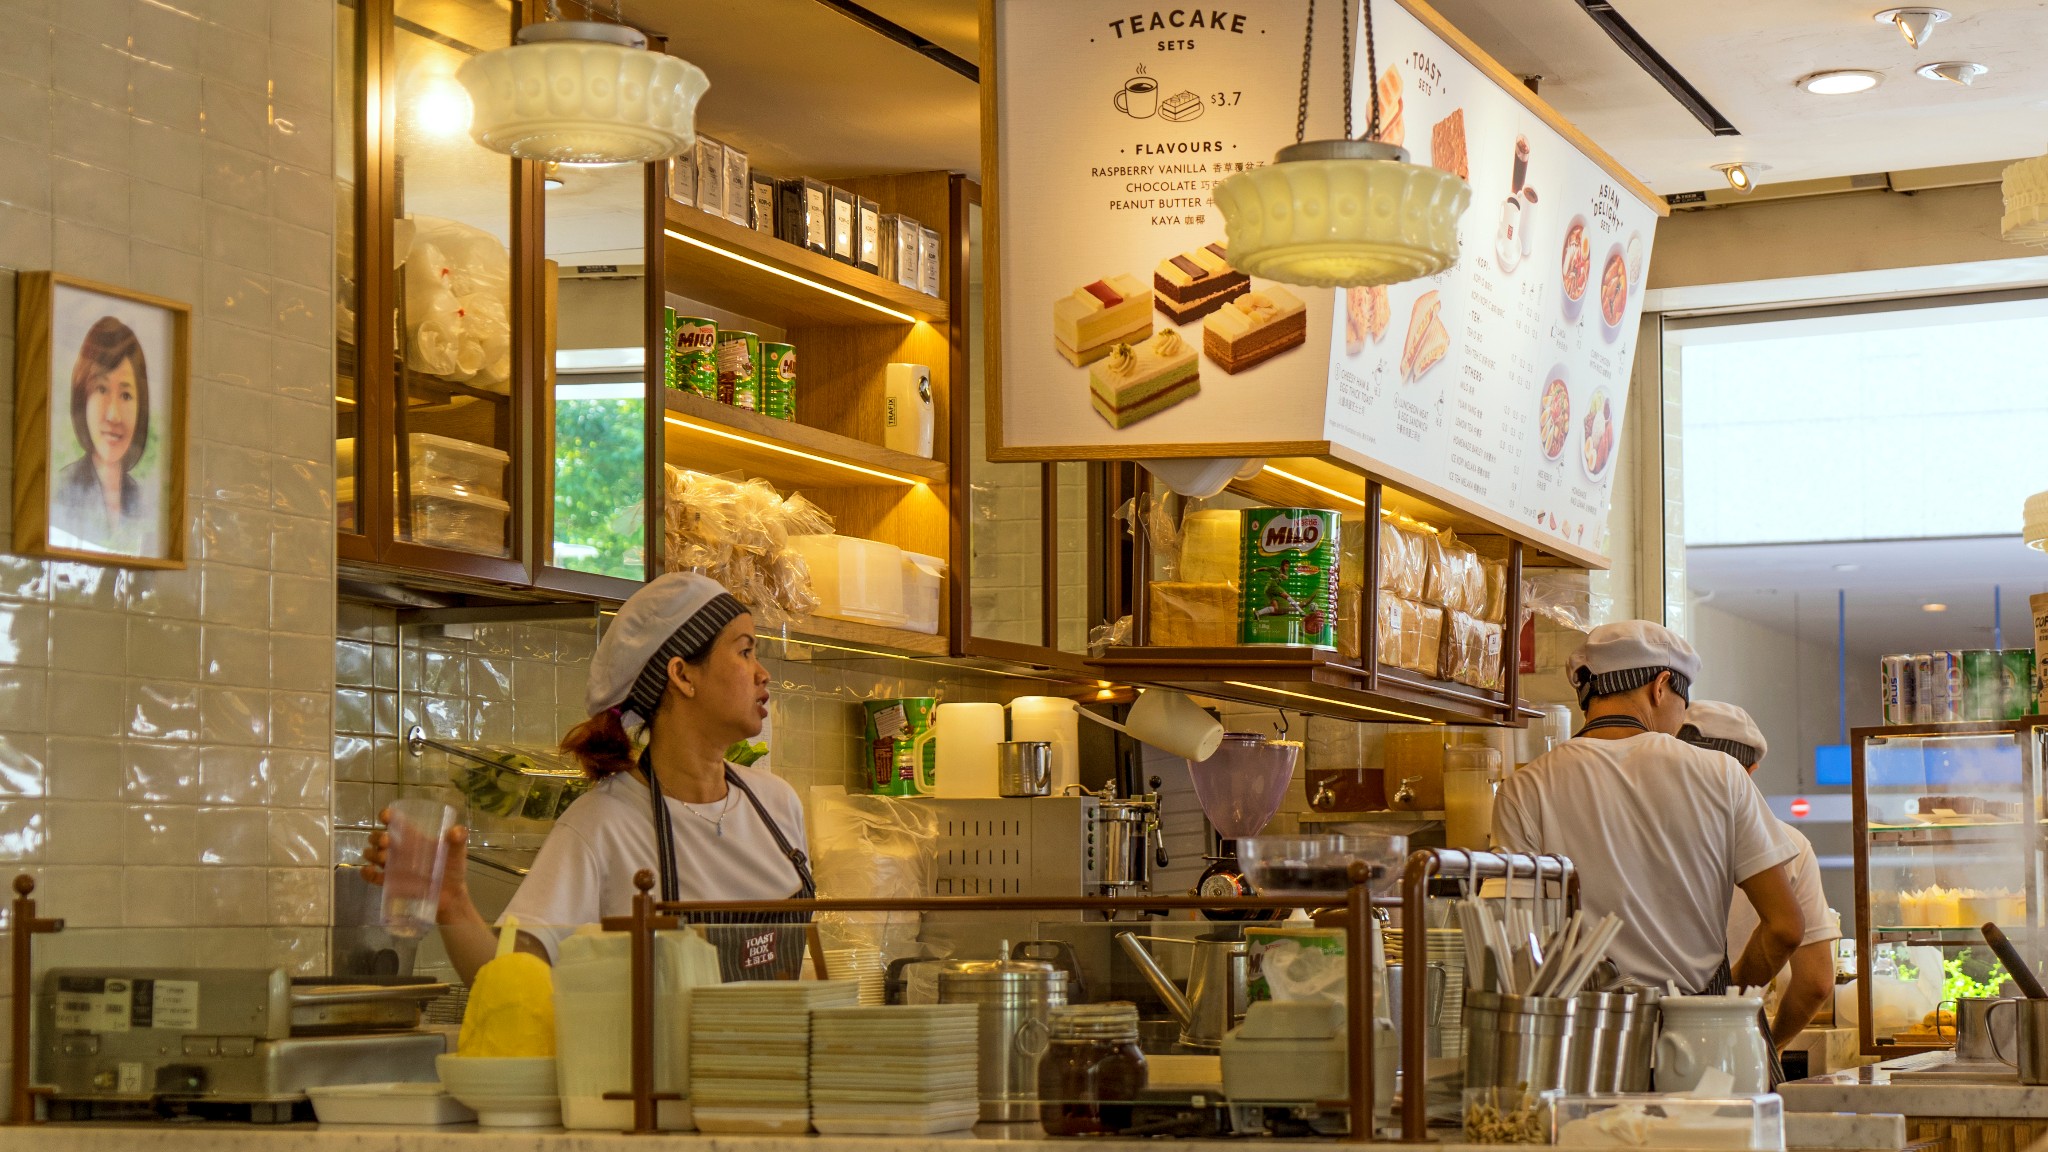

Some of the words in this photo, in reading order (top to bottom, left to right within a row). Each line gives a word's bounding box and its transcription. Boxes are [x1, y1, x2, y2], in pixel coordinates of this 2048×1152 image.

[1109, 9, 1247, 39] TEACAKE
[1157, 39, 1195, 51] SETS
[1412, 52, 1442, 87] TOAST
[1418, 78, 1432, 96] SETS
[1210, 92, 1242, 107] $3.7
[1136, 140, 1223, 155] FLAVOURS
[1091, 165, 1155, 177] RASPBERRY
[1158, 164, 1207, 174] VANILLA
[1126, 180, 1197, 193] CHOCOLATE
[1110, 199, 1155, 210] PEANUT
[1159, 198, 1202, 209] BUTTER
[1598, 184, 1620, 210] ASIAN
[1151, 216, 1181, 226] KAYA
[1594, 201, 1620, 232] DELIGHT
[677, 332, 714, 348] MILO
[1266, 526, 1318, 546] MILO
[745, 932, 774, 949] TOAST
[750, 944, 768, 958] BOX
